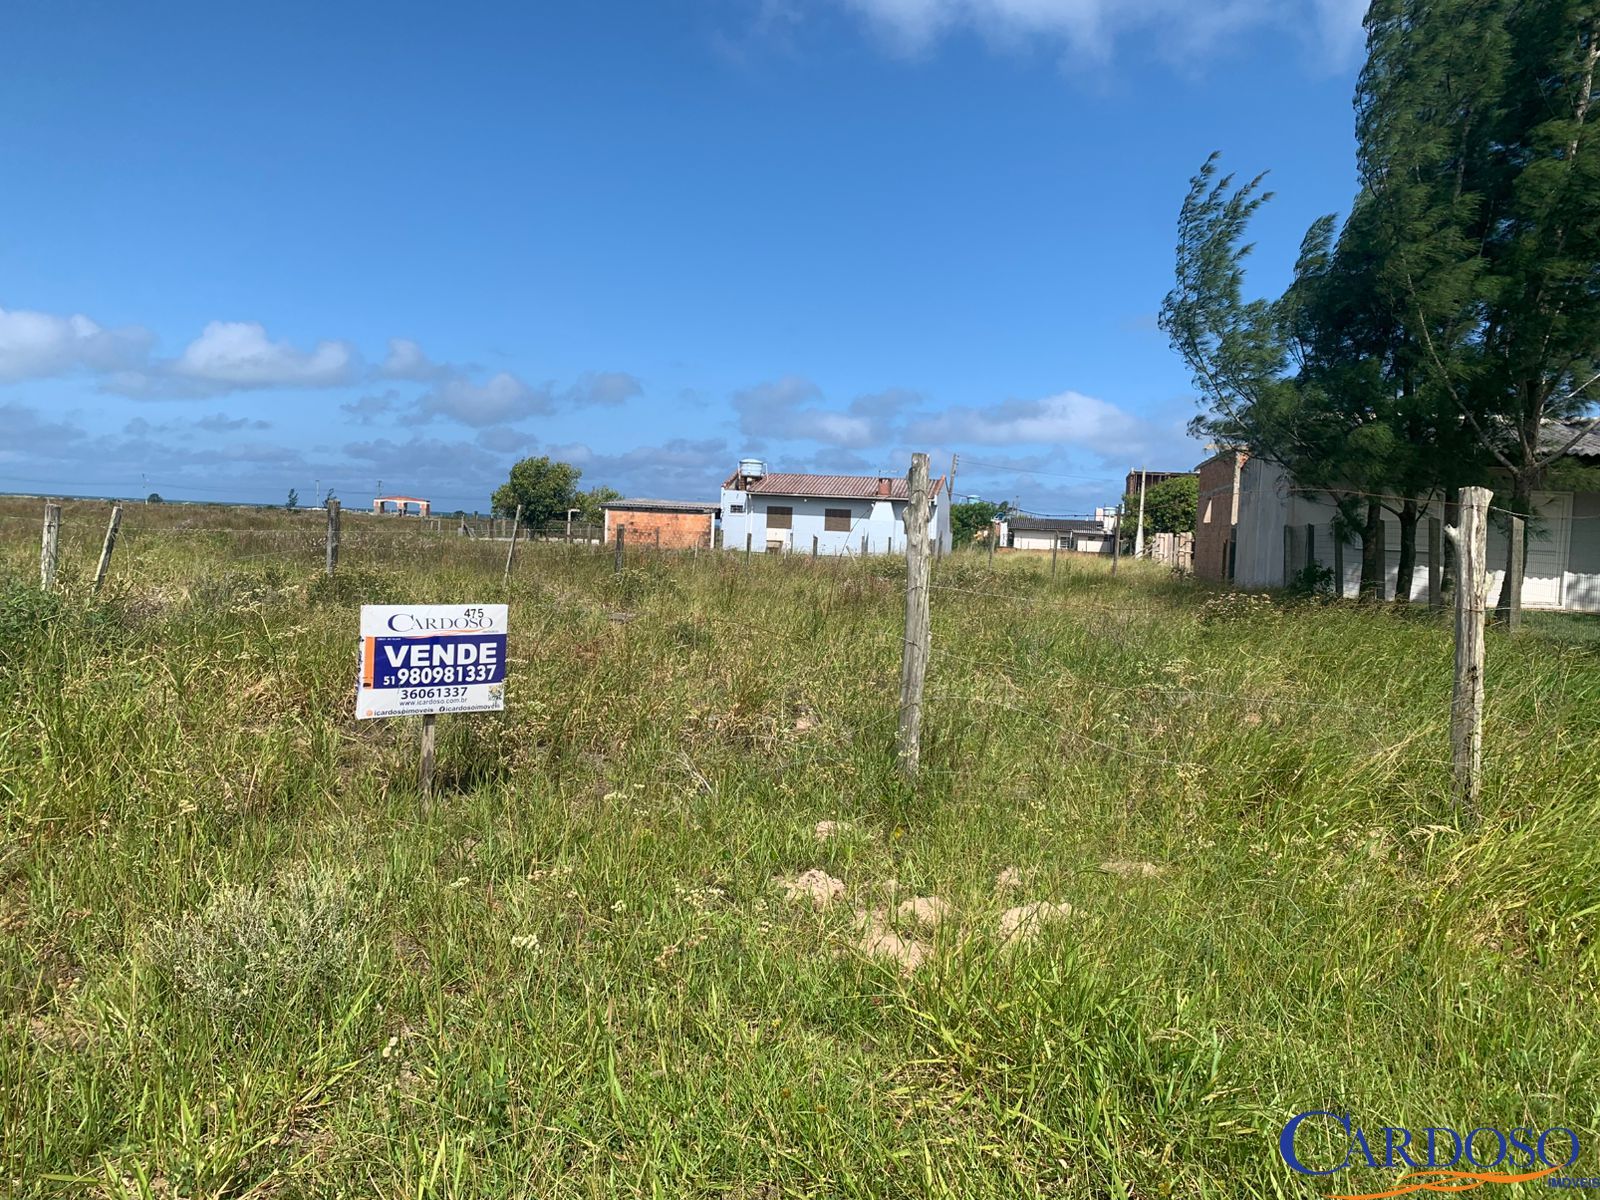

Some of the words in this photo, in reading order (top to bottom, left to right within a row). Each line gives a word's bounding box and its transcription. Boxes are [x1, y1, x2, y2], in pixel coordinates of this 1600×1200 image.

[464, 608, 484, 618] 475
[387, 613, 493, 633] CARDOSO
[384, 643, 497, 667] VENDE
[383, 676, 395, 685] 51
[397, 665, 497, 684] 980981337
[401, 687, 467, 699] 36061337
[399, 697, 467, 706] www.icardoso.com.br
